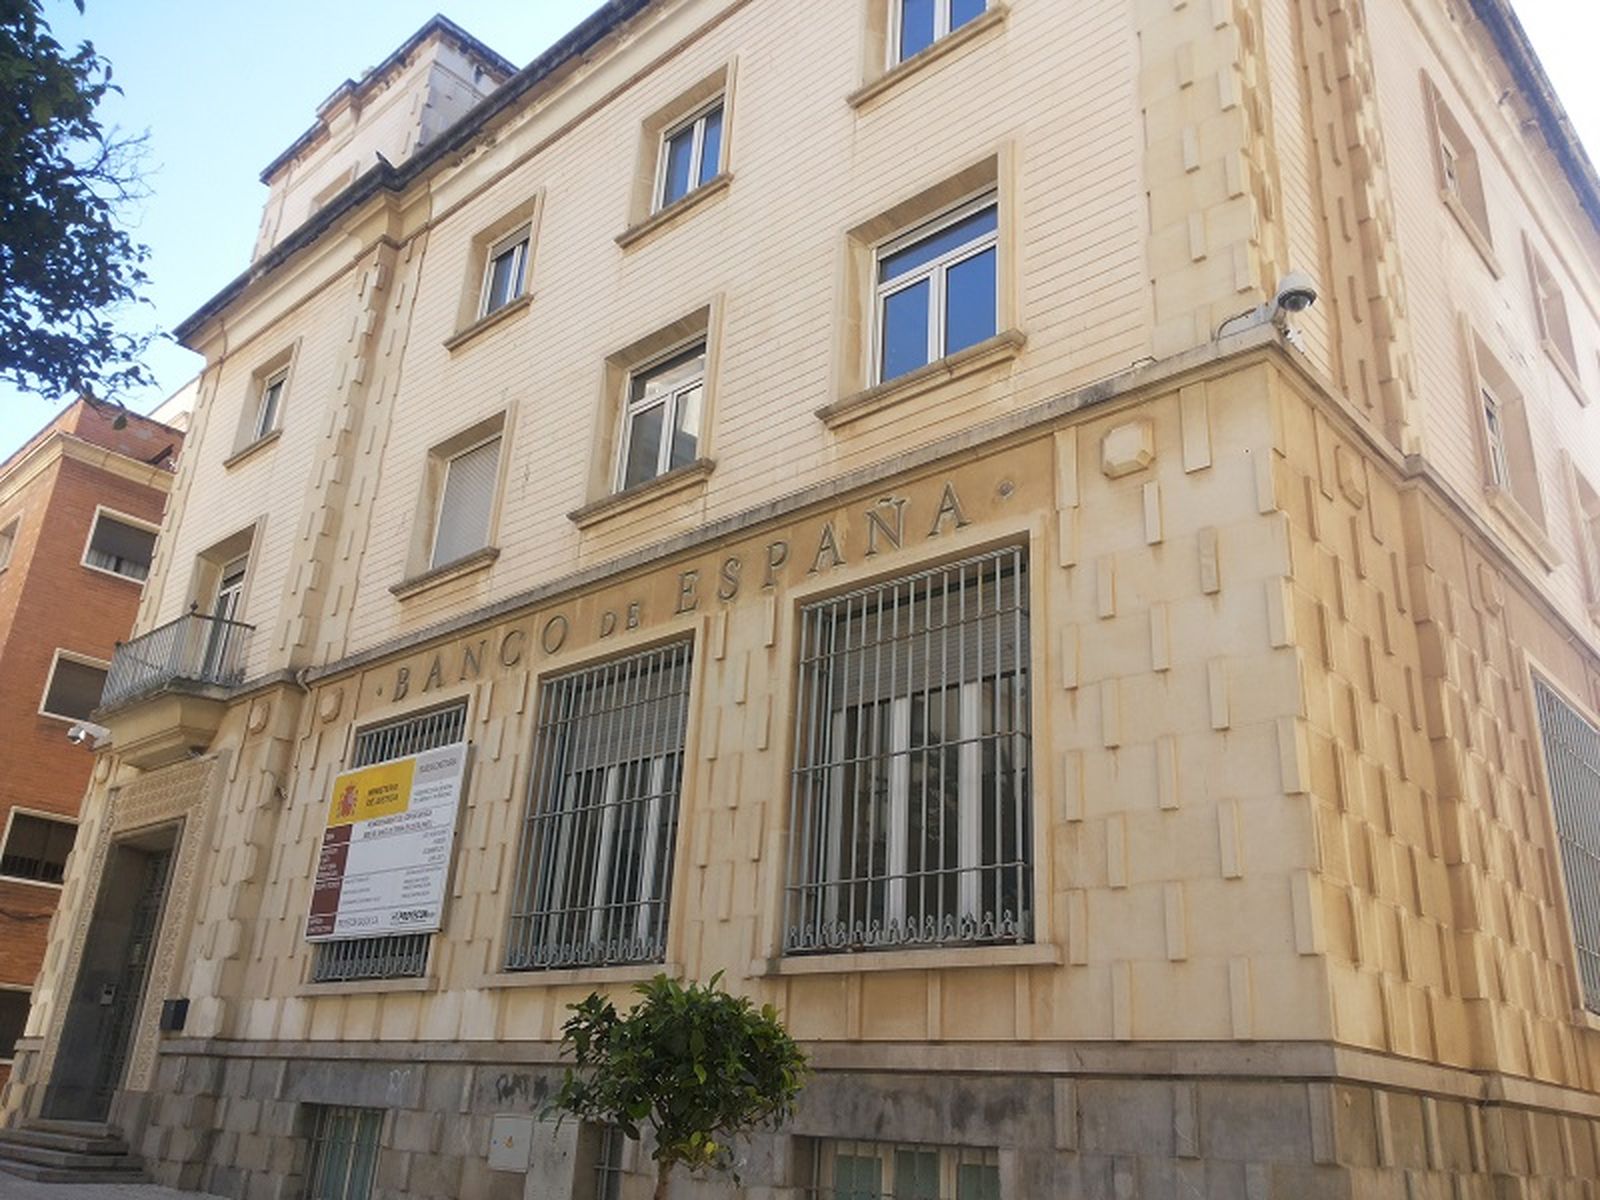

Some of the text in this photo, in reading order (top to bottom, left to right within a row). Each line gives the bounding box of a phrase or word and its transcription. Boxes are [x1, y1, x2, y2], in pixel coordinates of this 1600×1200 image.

[391, 480, 973, 702] BANCO DE ESPAÑA
